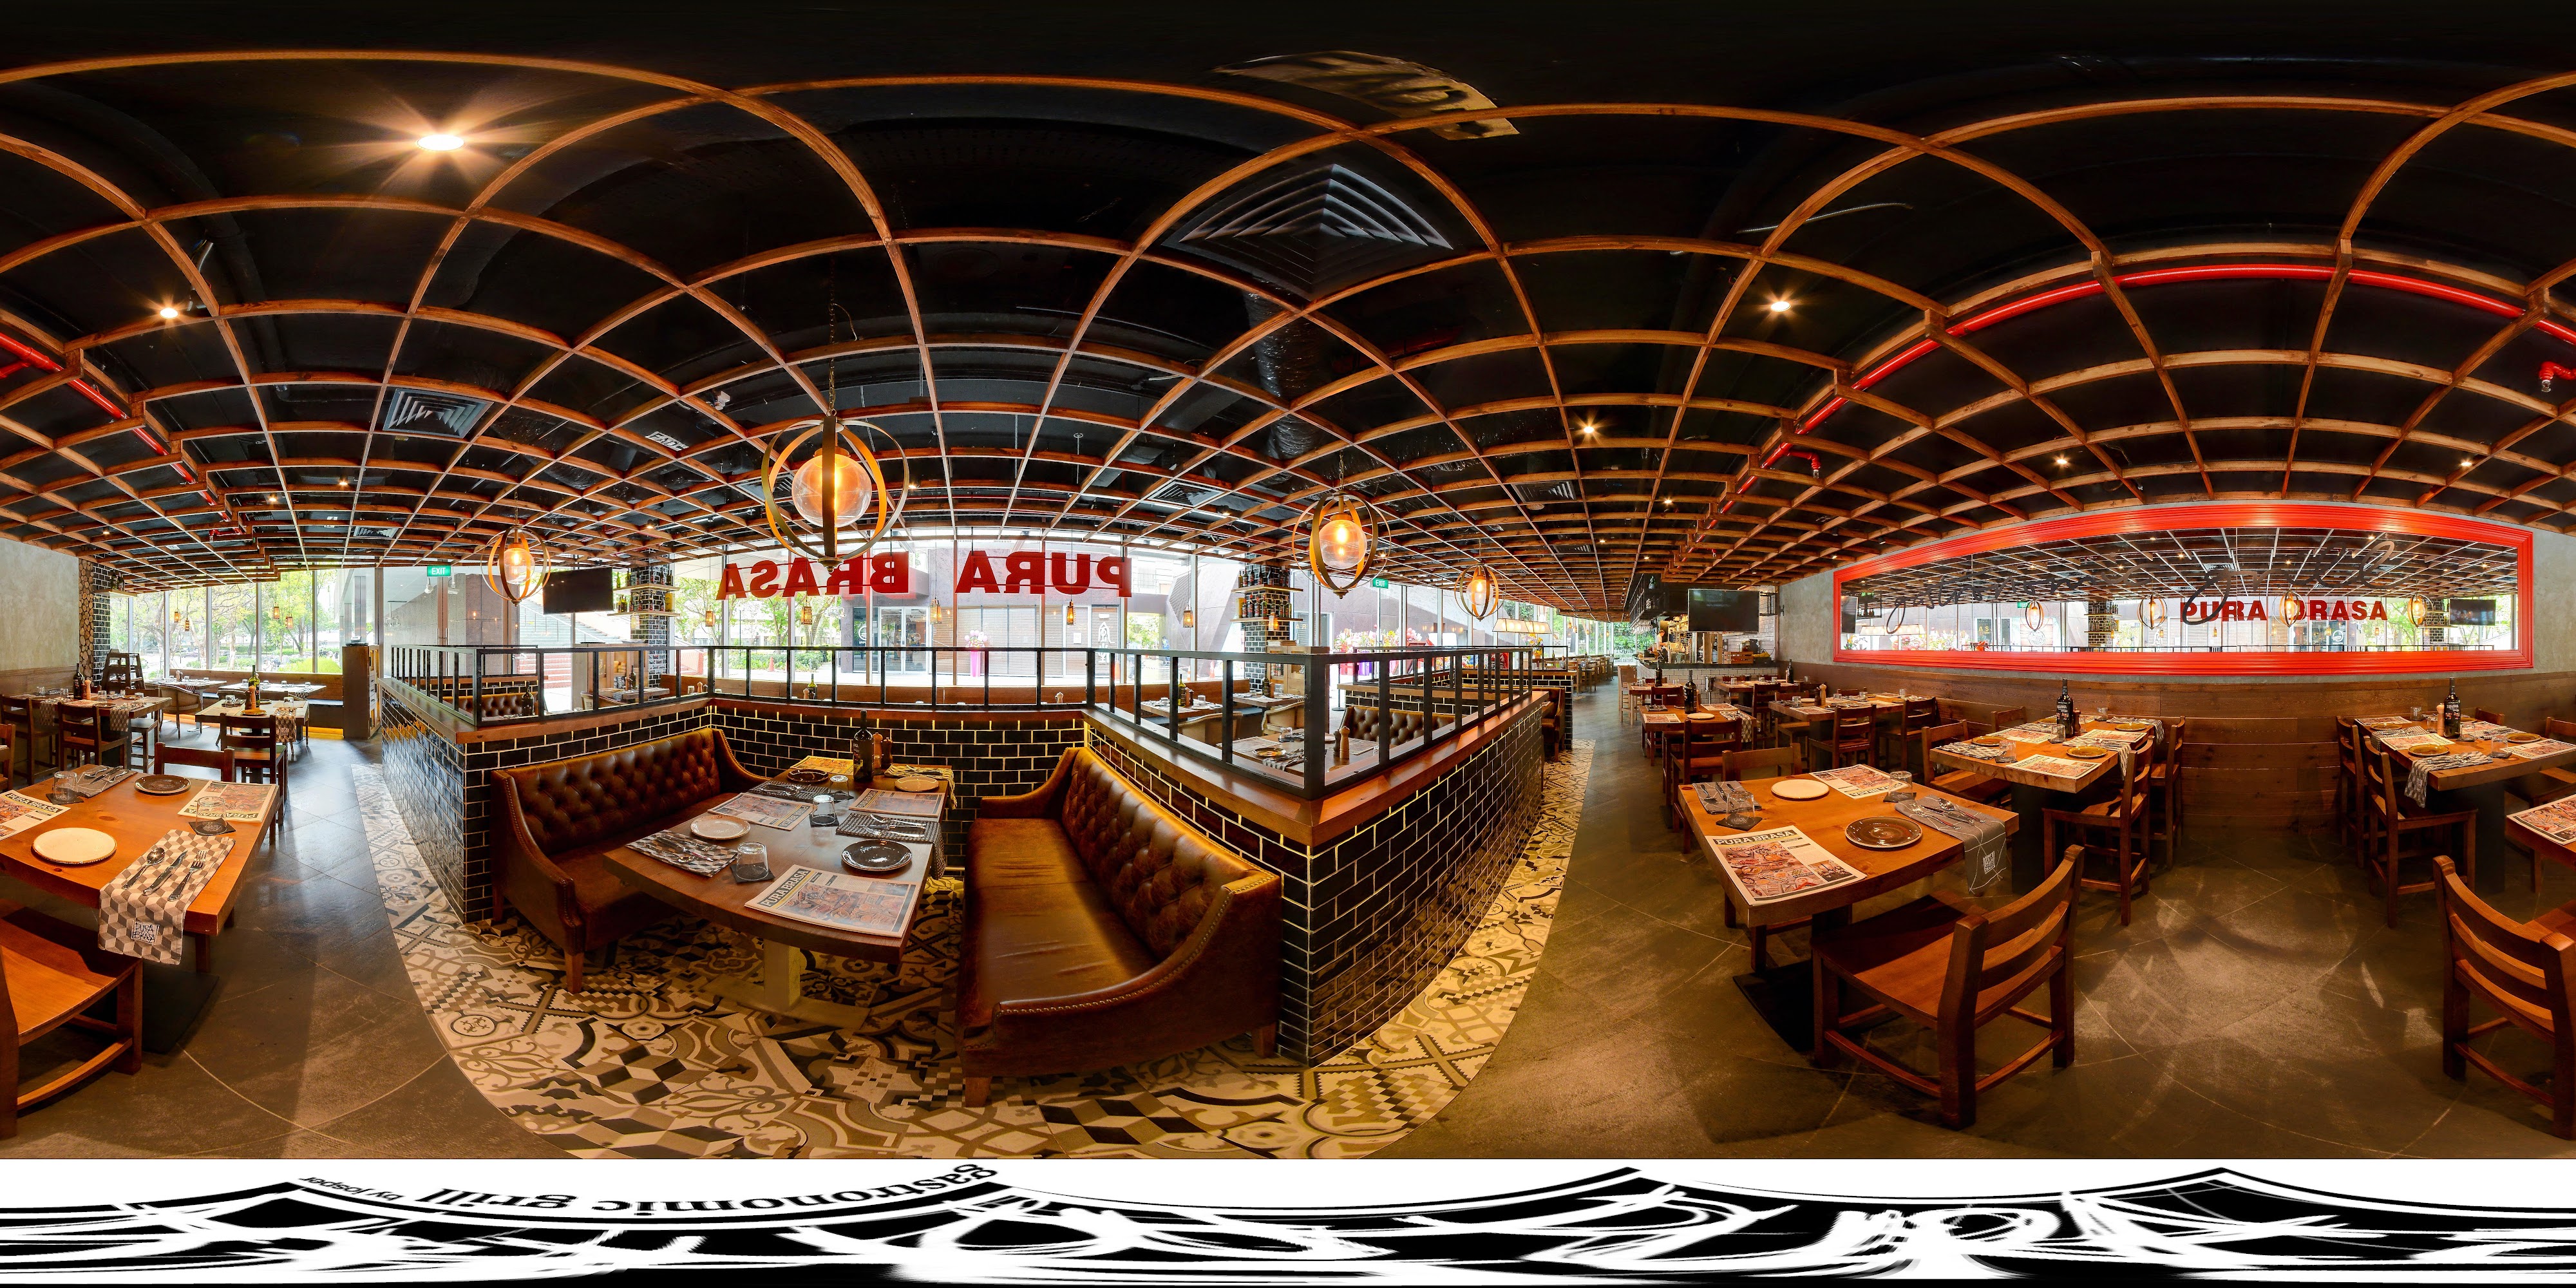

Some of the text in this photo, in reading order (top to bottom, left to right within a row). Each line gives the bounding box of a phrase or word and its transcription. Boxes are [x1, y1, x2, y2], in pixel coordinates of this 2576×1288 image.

[2180, 600, 2268, 622] PURA
[6, 793, 59, 813] PURA BRASA
[1716, 836, 1752, 845] PURA
[1750, 830, 1794, 841] BRASA
[761, 889, 789, 907] PURA
[783, 870, 809, 890] BRASA
